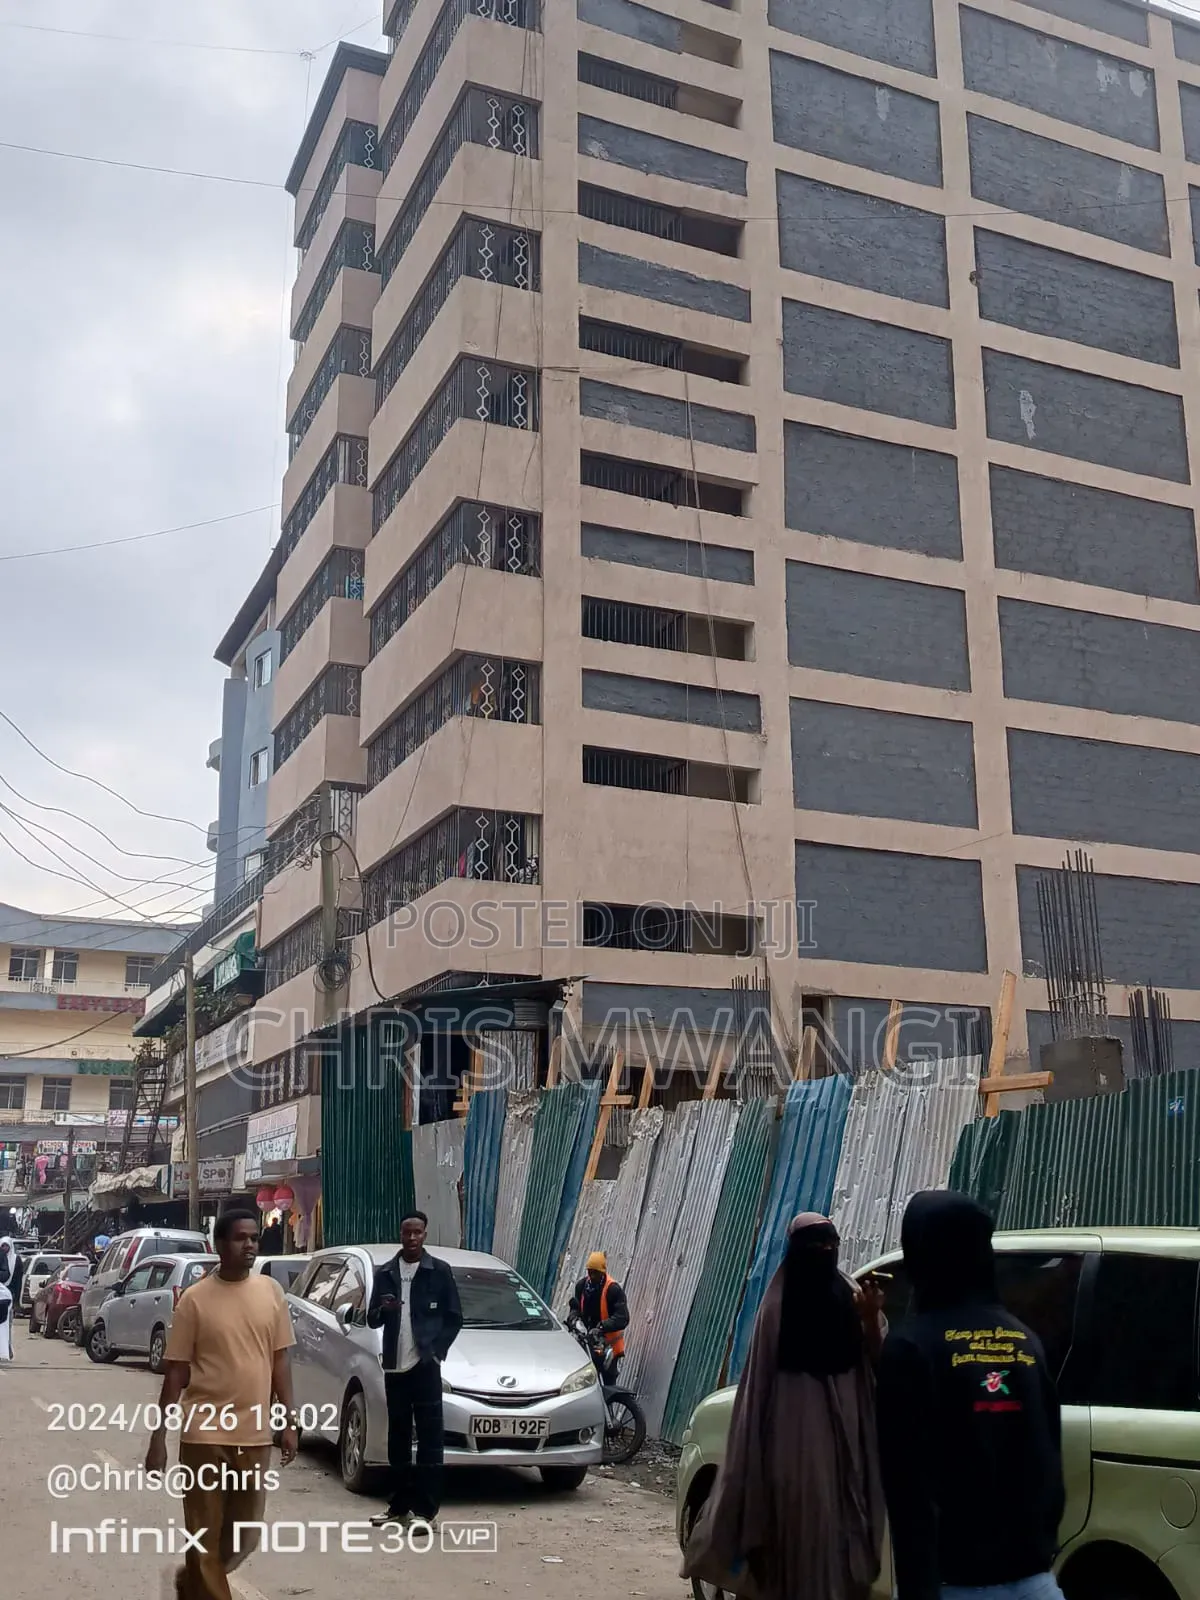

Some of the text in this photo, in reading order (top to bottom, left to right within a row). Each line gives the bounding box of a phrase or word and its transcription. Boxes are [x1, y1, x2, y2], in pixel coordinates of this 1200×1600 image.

[202, 1167, 233, 1180] SPOT
[473, 1418, 548, 1435] KDB 192F
